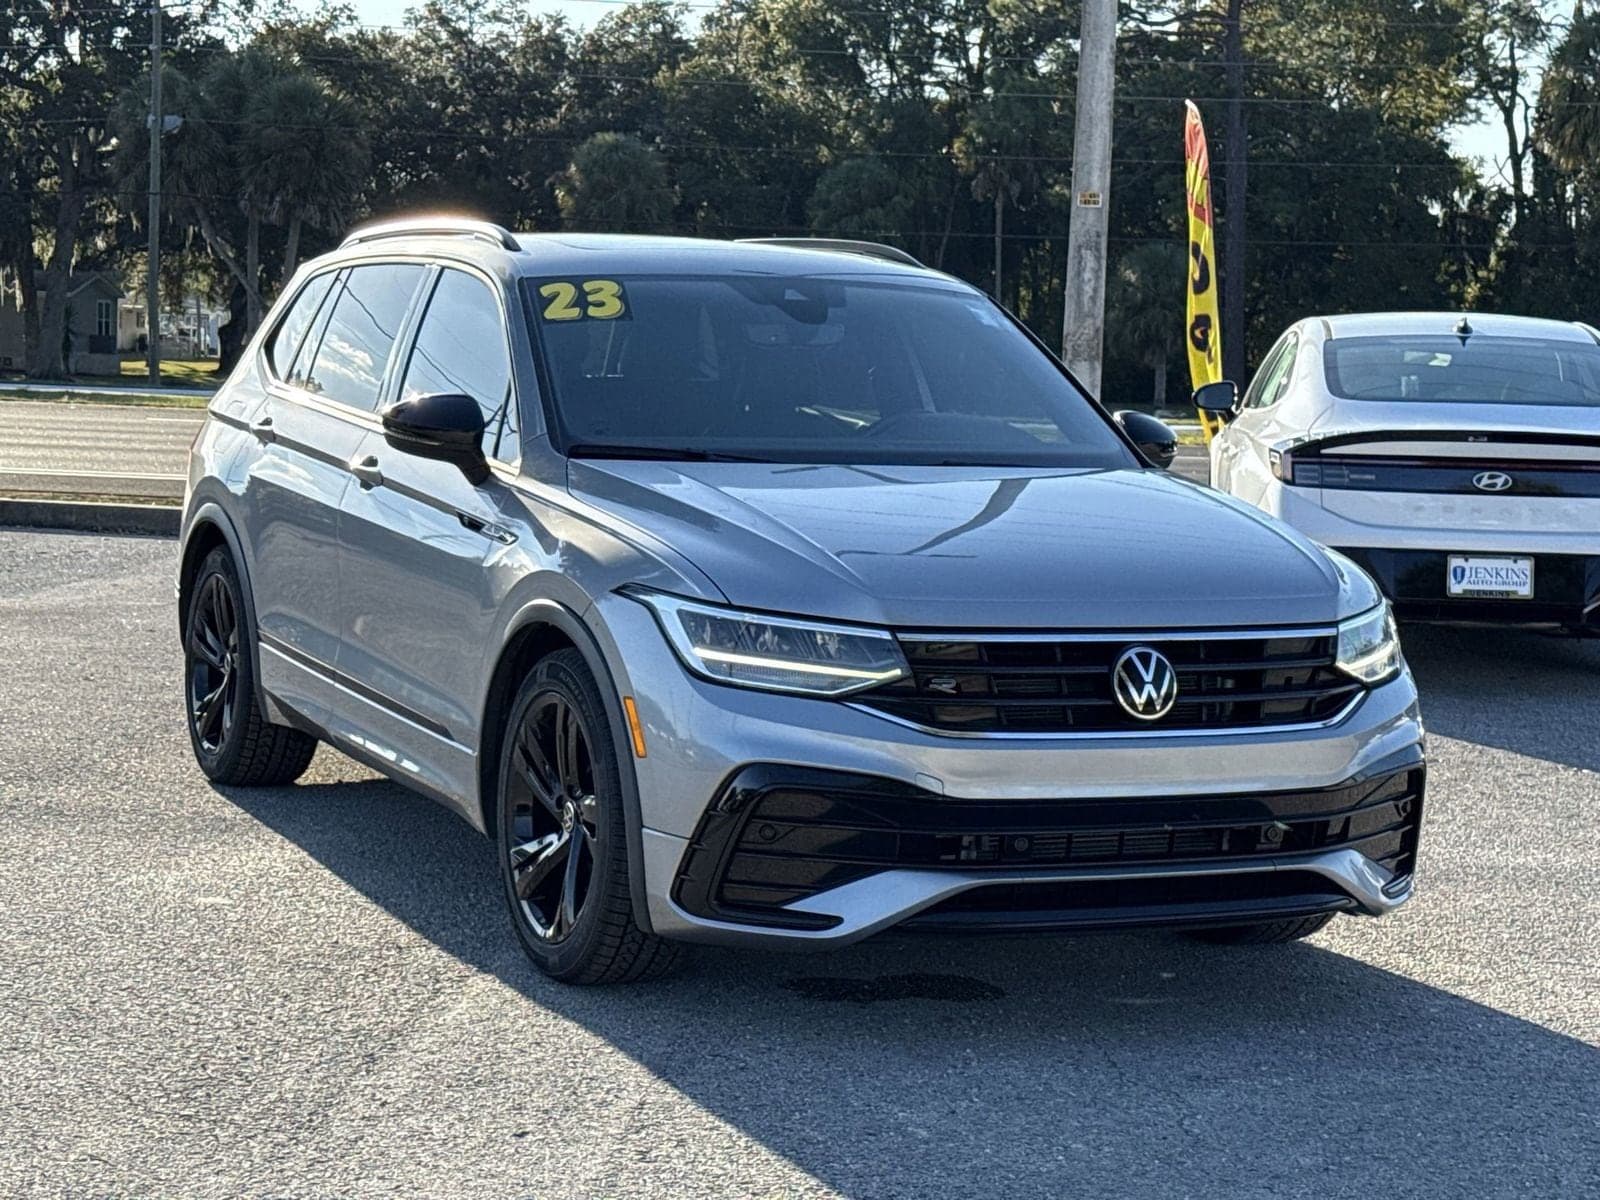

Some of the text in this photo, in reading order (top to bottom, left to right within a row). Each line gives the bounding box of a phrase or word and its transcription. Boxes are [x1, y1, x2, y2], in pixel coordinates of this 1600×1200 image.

[540, 280, 625, 320] 23
[1466, 579, 1529, 588] AUTO GROUP
[1468, 566, 1529, 581] JENKINS
[1115, 648, 1175, 717] VW
